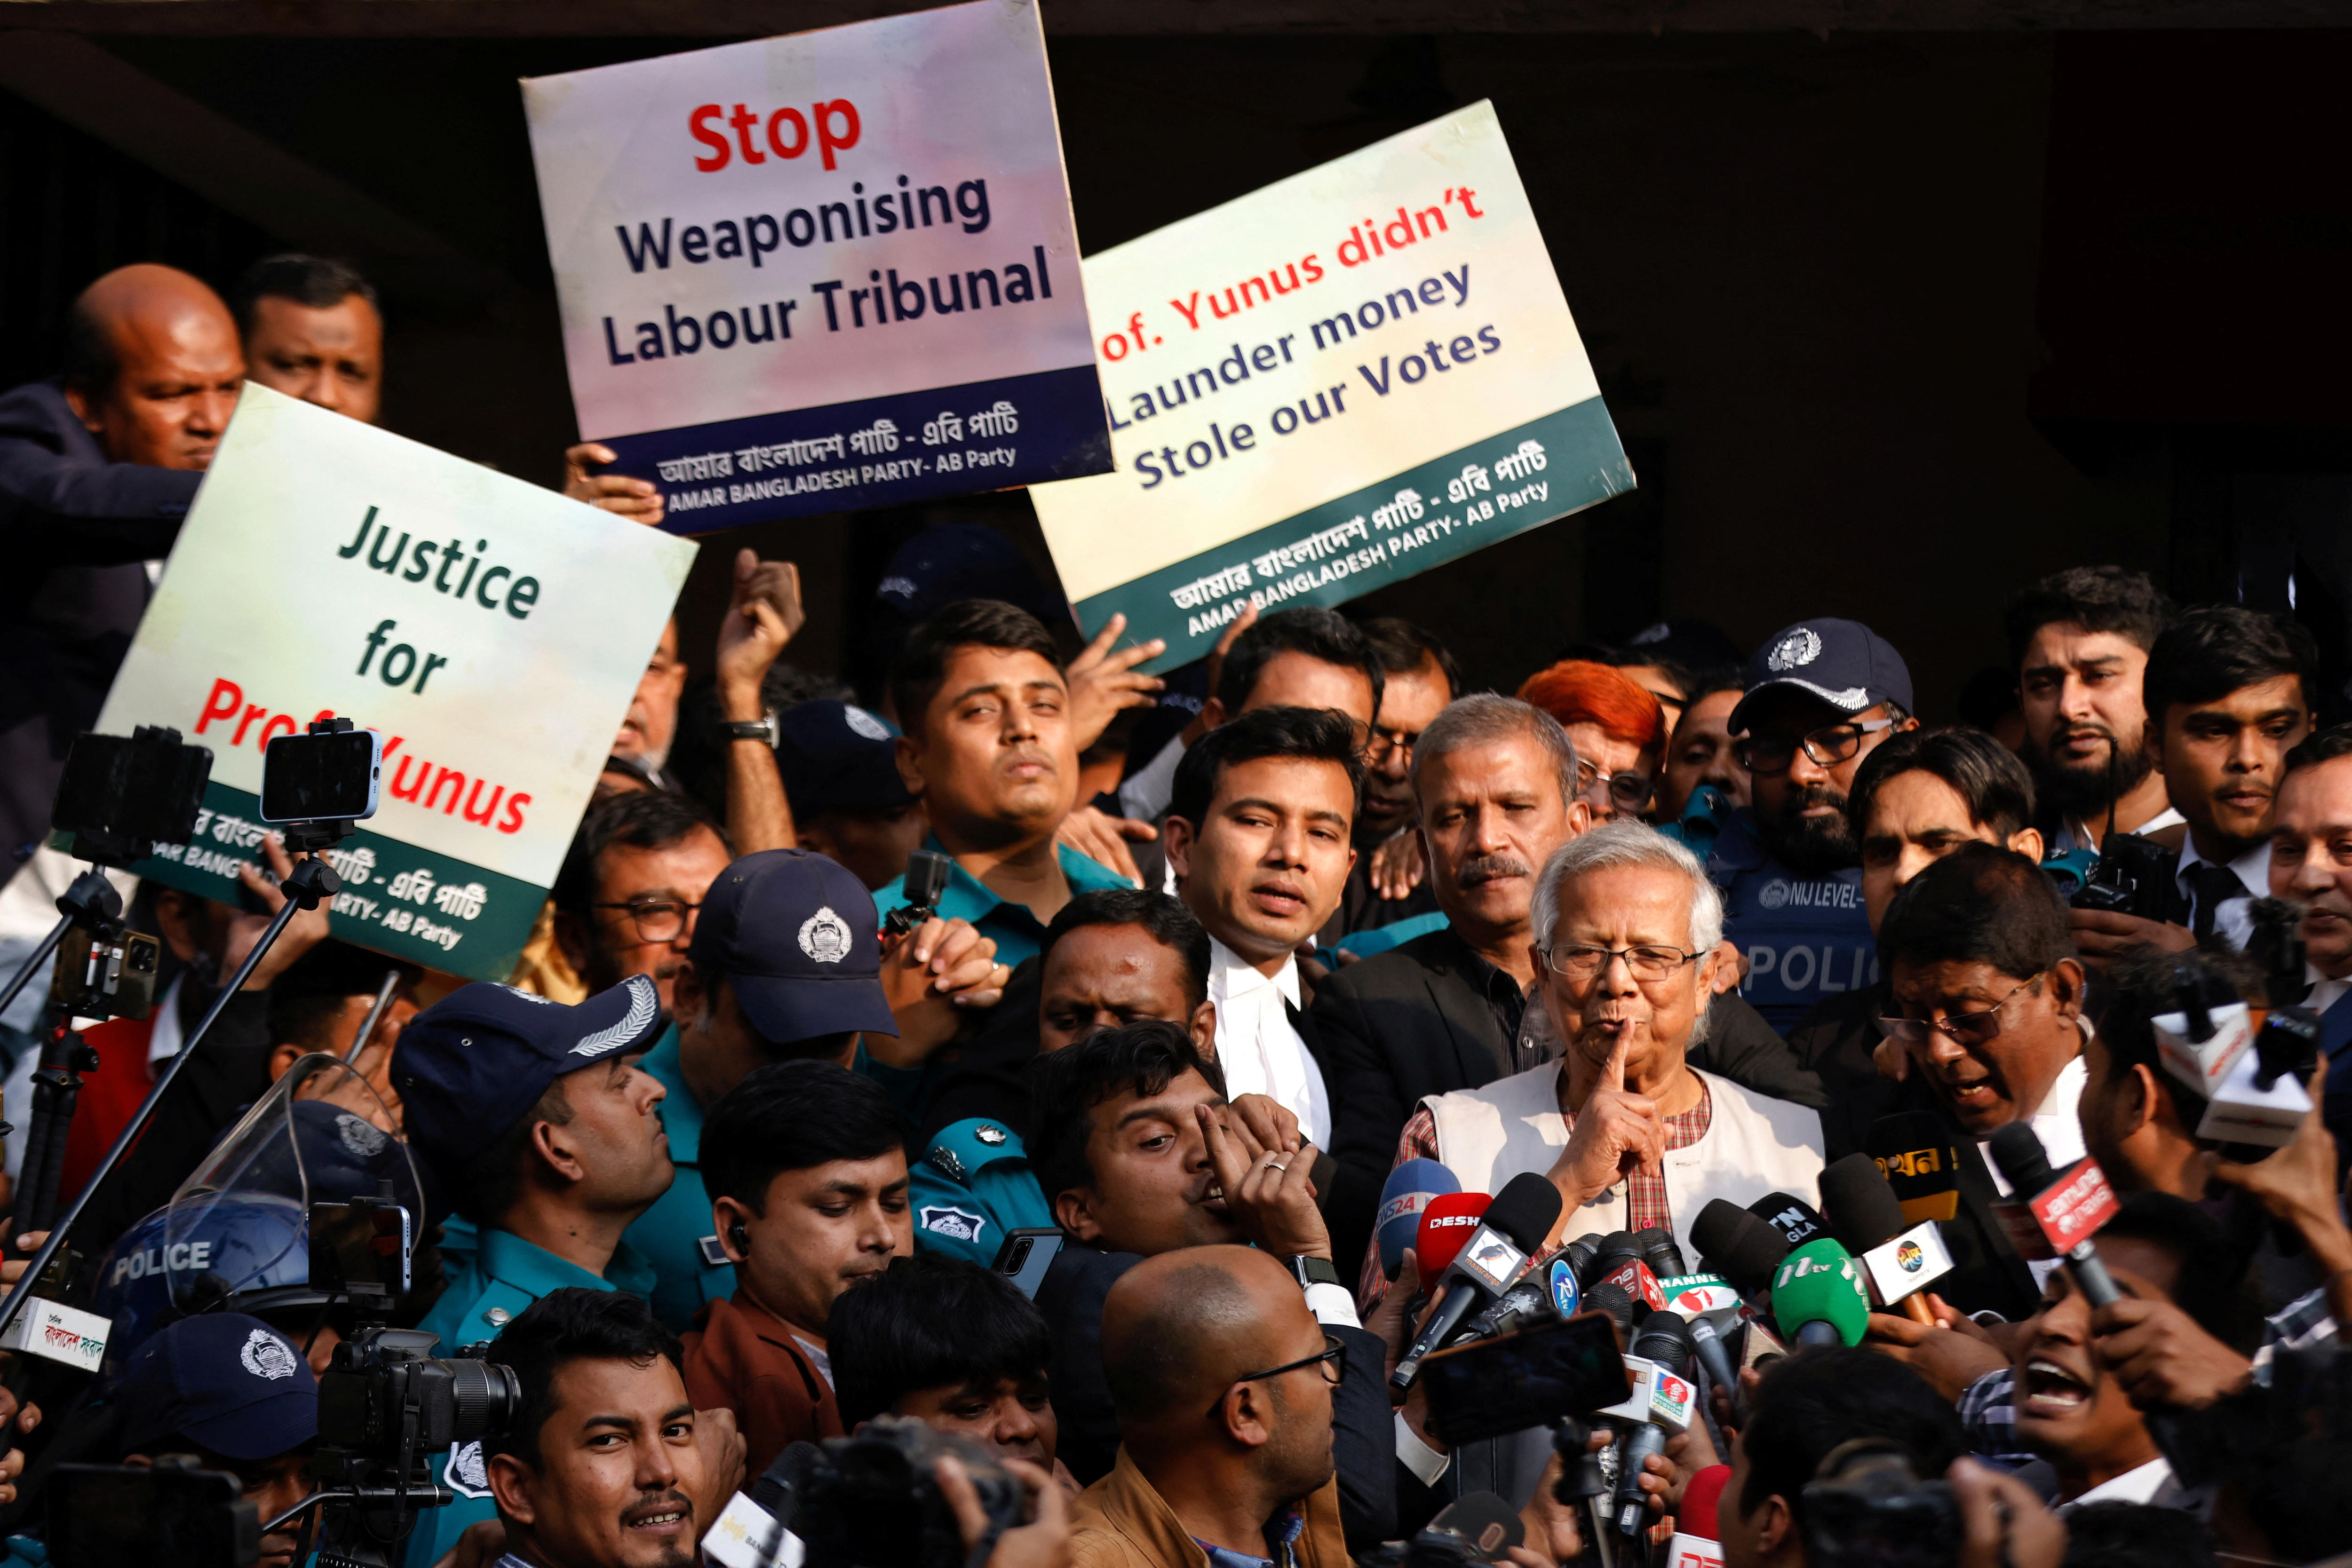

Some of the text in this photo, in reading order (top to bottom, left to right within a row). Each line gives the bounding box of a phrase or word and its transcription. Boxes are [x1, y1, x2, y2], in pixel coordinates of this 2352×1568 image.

[688, 98, 861, 173] Stop
[616, 175, 991, 273] Weaponising
[603, 245, 1053, 366] Labour Tribunal
[1102, 312, 1163, 361] of.
[1168, 252, 1324, 331] Yunus
[1106, 264, 1470, 432] Launder money
[1132, 324, 1503, 491] Stole our Votes
[657, 451, 733, 484] আমার
[737, 434, 844, 472] বাংলাদেশ
[922, 411, 963, 446] এবি
[668, 484, 727, 513] AMAR
[731, 467, 858, 504] BANGLADESH
[936, 454, 963, 474] AB
[966, 447, 1017, 468] Party
[338, 504, 541, 620] Justice
[1169, 562, 1252, 609] আমার
[1251, 515, 1368, 578] বাংলাদেশ
[1430, 497, 1441, 506] -
[1447, 463, 1491, 505] এবি
[1250, 543, 1387, 610] BANGLADESH
[1466, 501, 1495, 526] AB
[1499, 480, 1549, 513] Party
[356, 618, 447, 696] for
[373, 876, 386, 885] -
[387, 868, 437, 905] এবি
[1789, 882, 1813, 906] NIJ
[381, 908, 414, 932] AB
[410, 916, 463, 951] Party
[1430, 1216, 1481, 1229] DESH
[1768, 1207, 1807, 1228] TN
[113, 1242, 211, 1286] POLICE
[1464, 1258, 1501, 1287] maasranga
[1778, 1257, 1832, 1289] ntv
[45, 1325, 80, 1352] বাংলাদেশ
[80, 1337, 104, 1359] সংবাদ
[1653, 1398, 1682, 1417] VISION
[1654, 1393, 1682, 1410] BANGLA
